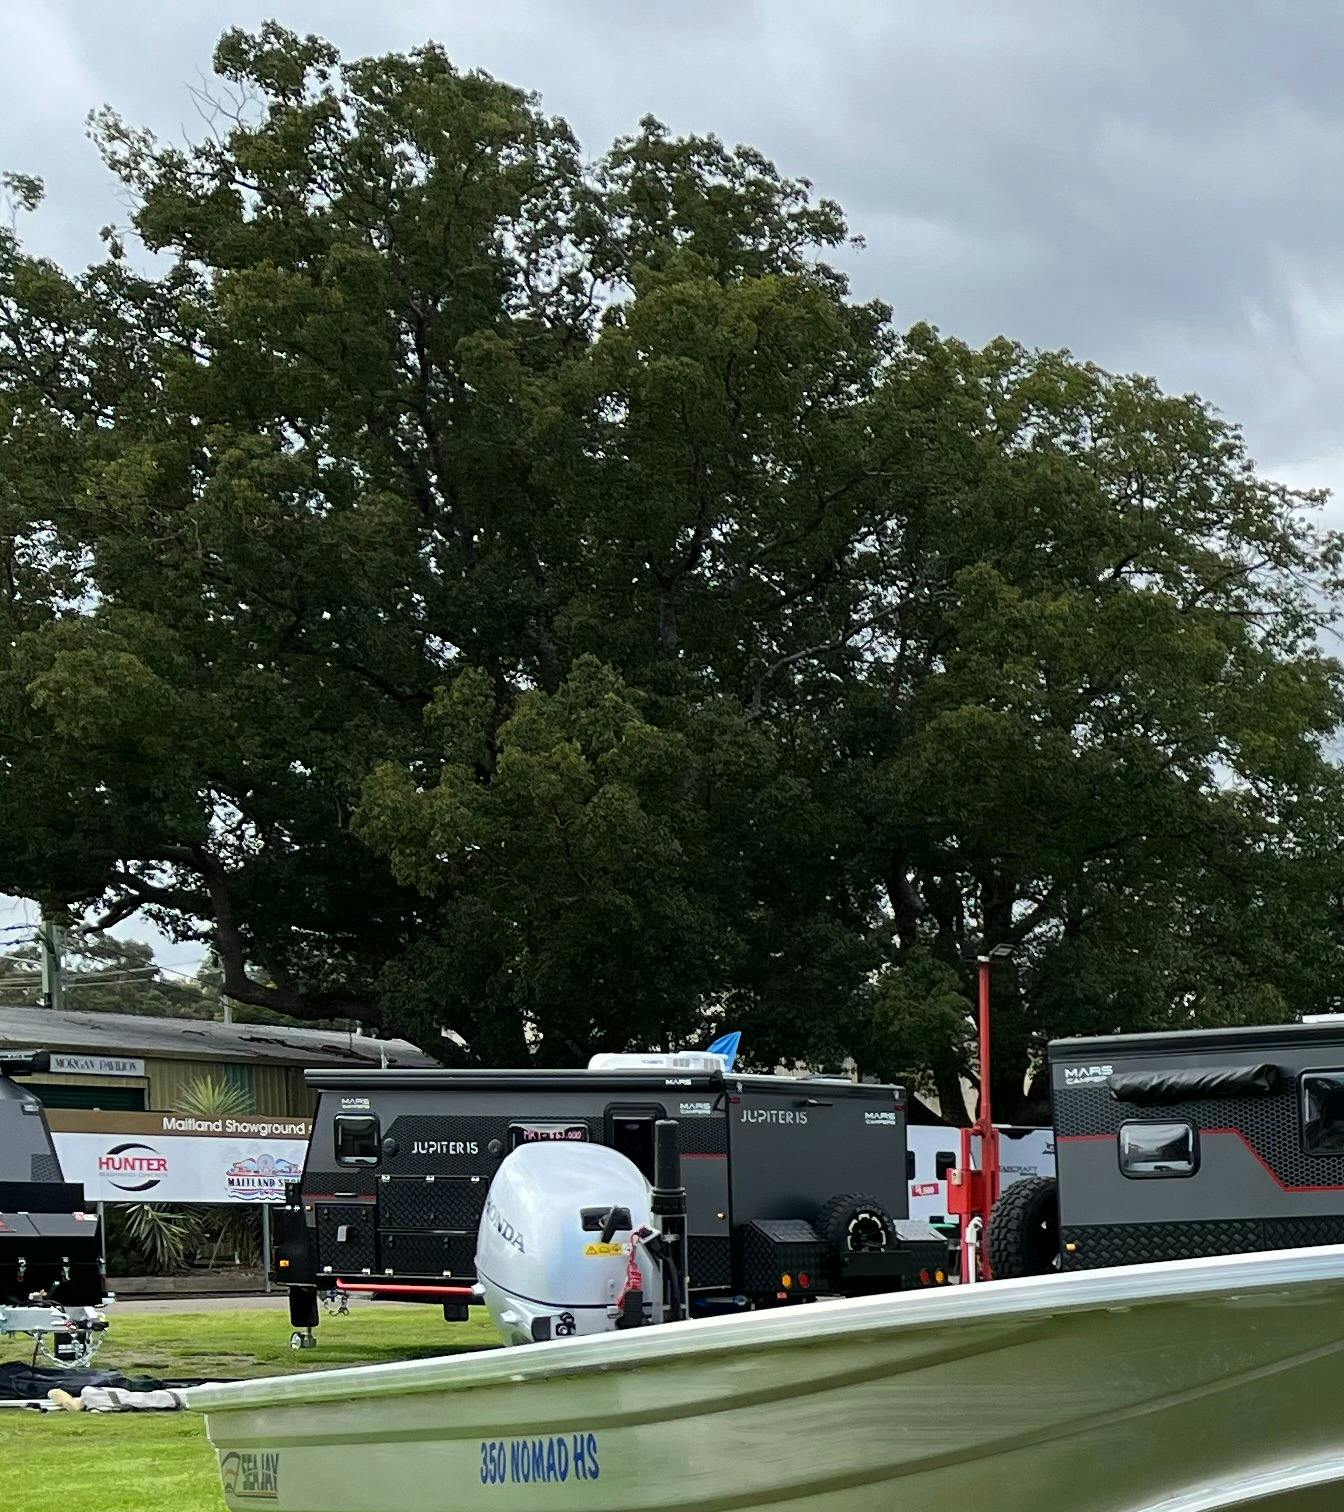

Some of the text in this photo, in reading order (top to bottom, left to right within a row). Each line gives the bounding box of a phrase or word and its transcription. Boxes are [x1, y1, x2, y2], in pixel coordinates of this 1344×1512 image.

[55, 1057, 137, 1072] MORGAN PAVILION
[1064, 1065, 1114, 1078] MARS
[740, 1109, 808, 1125] JUPITER 15
[864, 1112, 896, 1120] MARS
[162, 1117, 306, 1137] Maitland Showground
[412, 1141, 479, 1155] JUPITER 15
[98, 1157, 168, 1172] HUNTER
[227, 1177, 276, 1188] MAITLAND
[480, 1432, 600, 1485] 350 NOMAD HS
